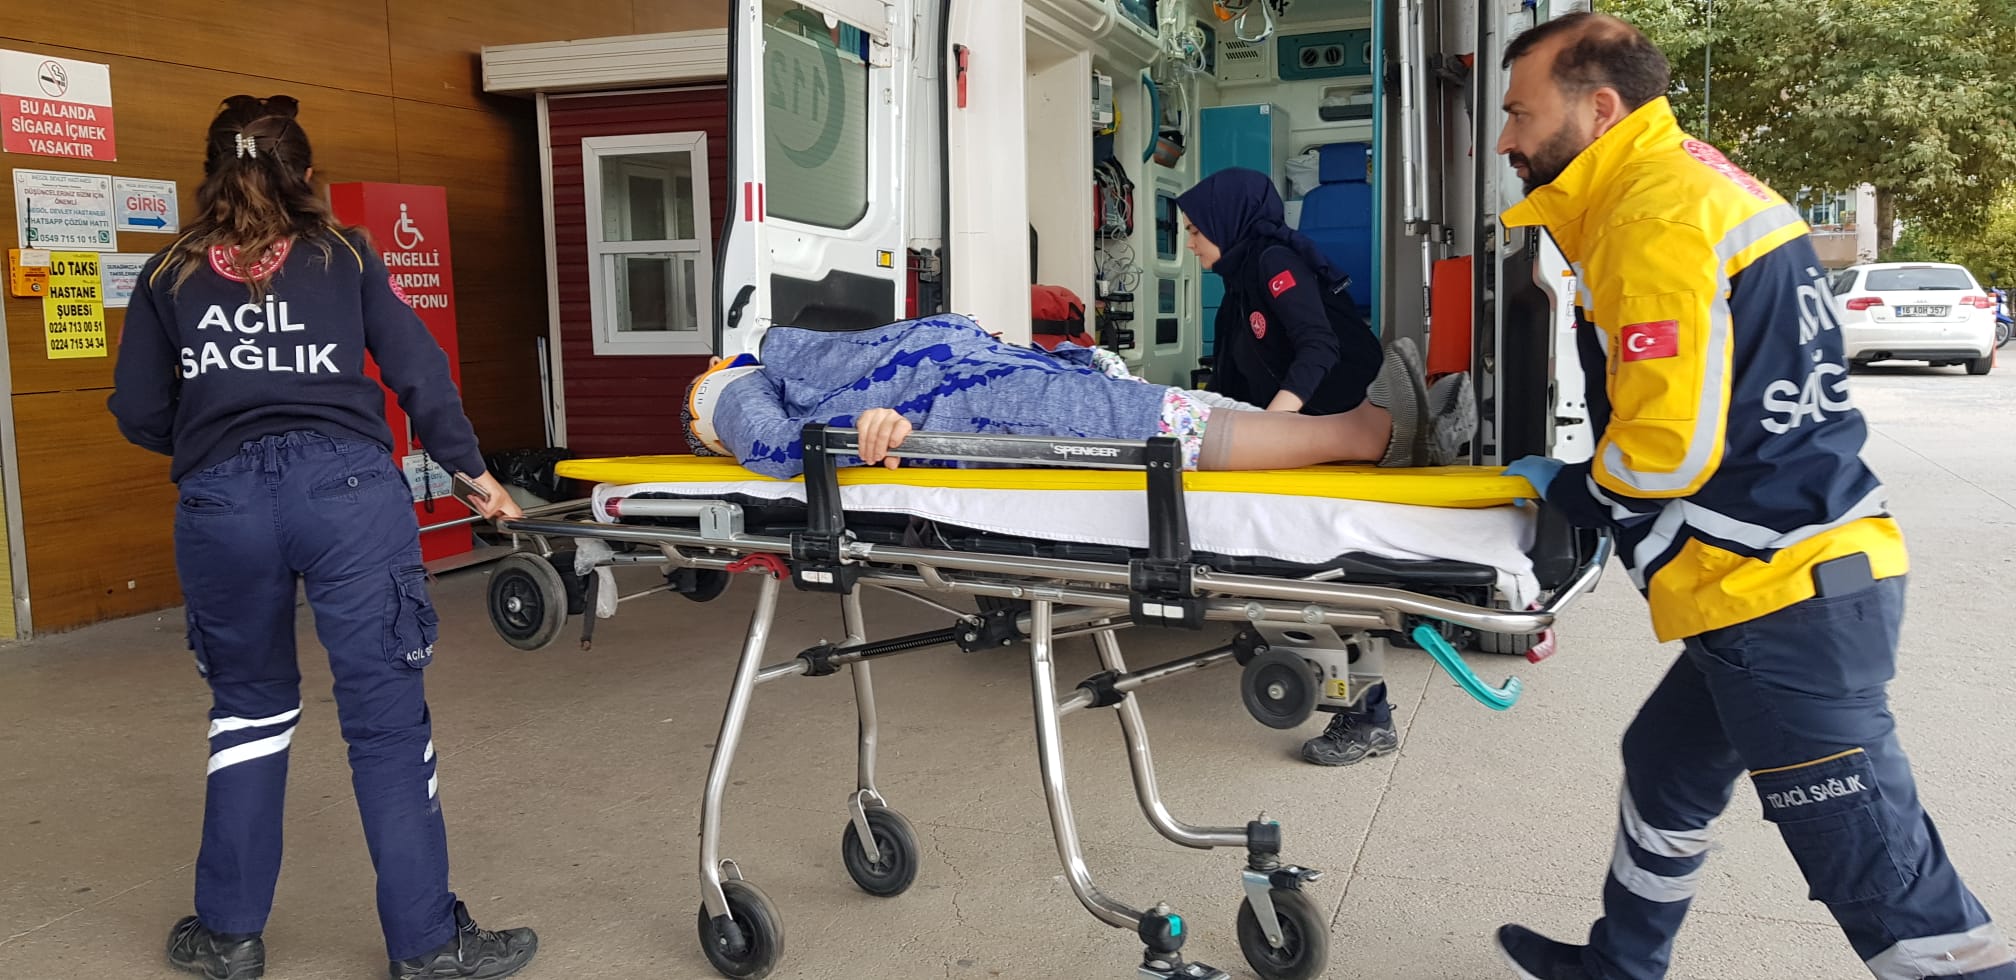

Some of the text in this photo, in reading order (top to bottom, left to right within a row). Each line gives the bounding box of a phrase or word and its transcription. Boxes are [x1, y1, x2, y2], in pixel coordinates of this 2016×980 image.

[20, 100, 96, 121] BU ALANDA
[12, 116, 107, 141] SİGARA İÇMEK
[29, 139, 94, 157] YASAKTIR
[126, 193, 167, 216] GİRİŞ
[64, 219, 88, 227] ÇÖZÜM
[40, 234, 59, 242] 0549
[61, 235, 75, 243] 715
[88, 236, 97, 244] 15
[383, 249, 440, 267] ENGELLİ
[50, 261, 65, 276] LO
[394, 274, 440, 288] ARDIM
[50, 286, 96, 298] HASTANE
[197, 295, 305, 333] ACİL
[50, 321, 103, 333] 0224 713 00 51
[51, 338, 104, 350] 0224 715 34 34
[181, 338, 340, 379] SAĞLIK
[1760, 349, 1850, 434] SAĞ
[1053, 445, 1120, 460] SPENCER
[1809, 774, 1868, 802] SAĞLIK
